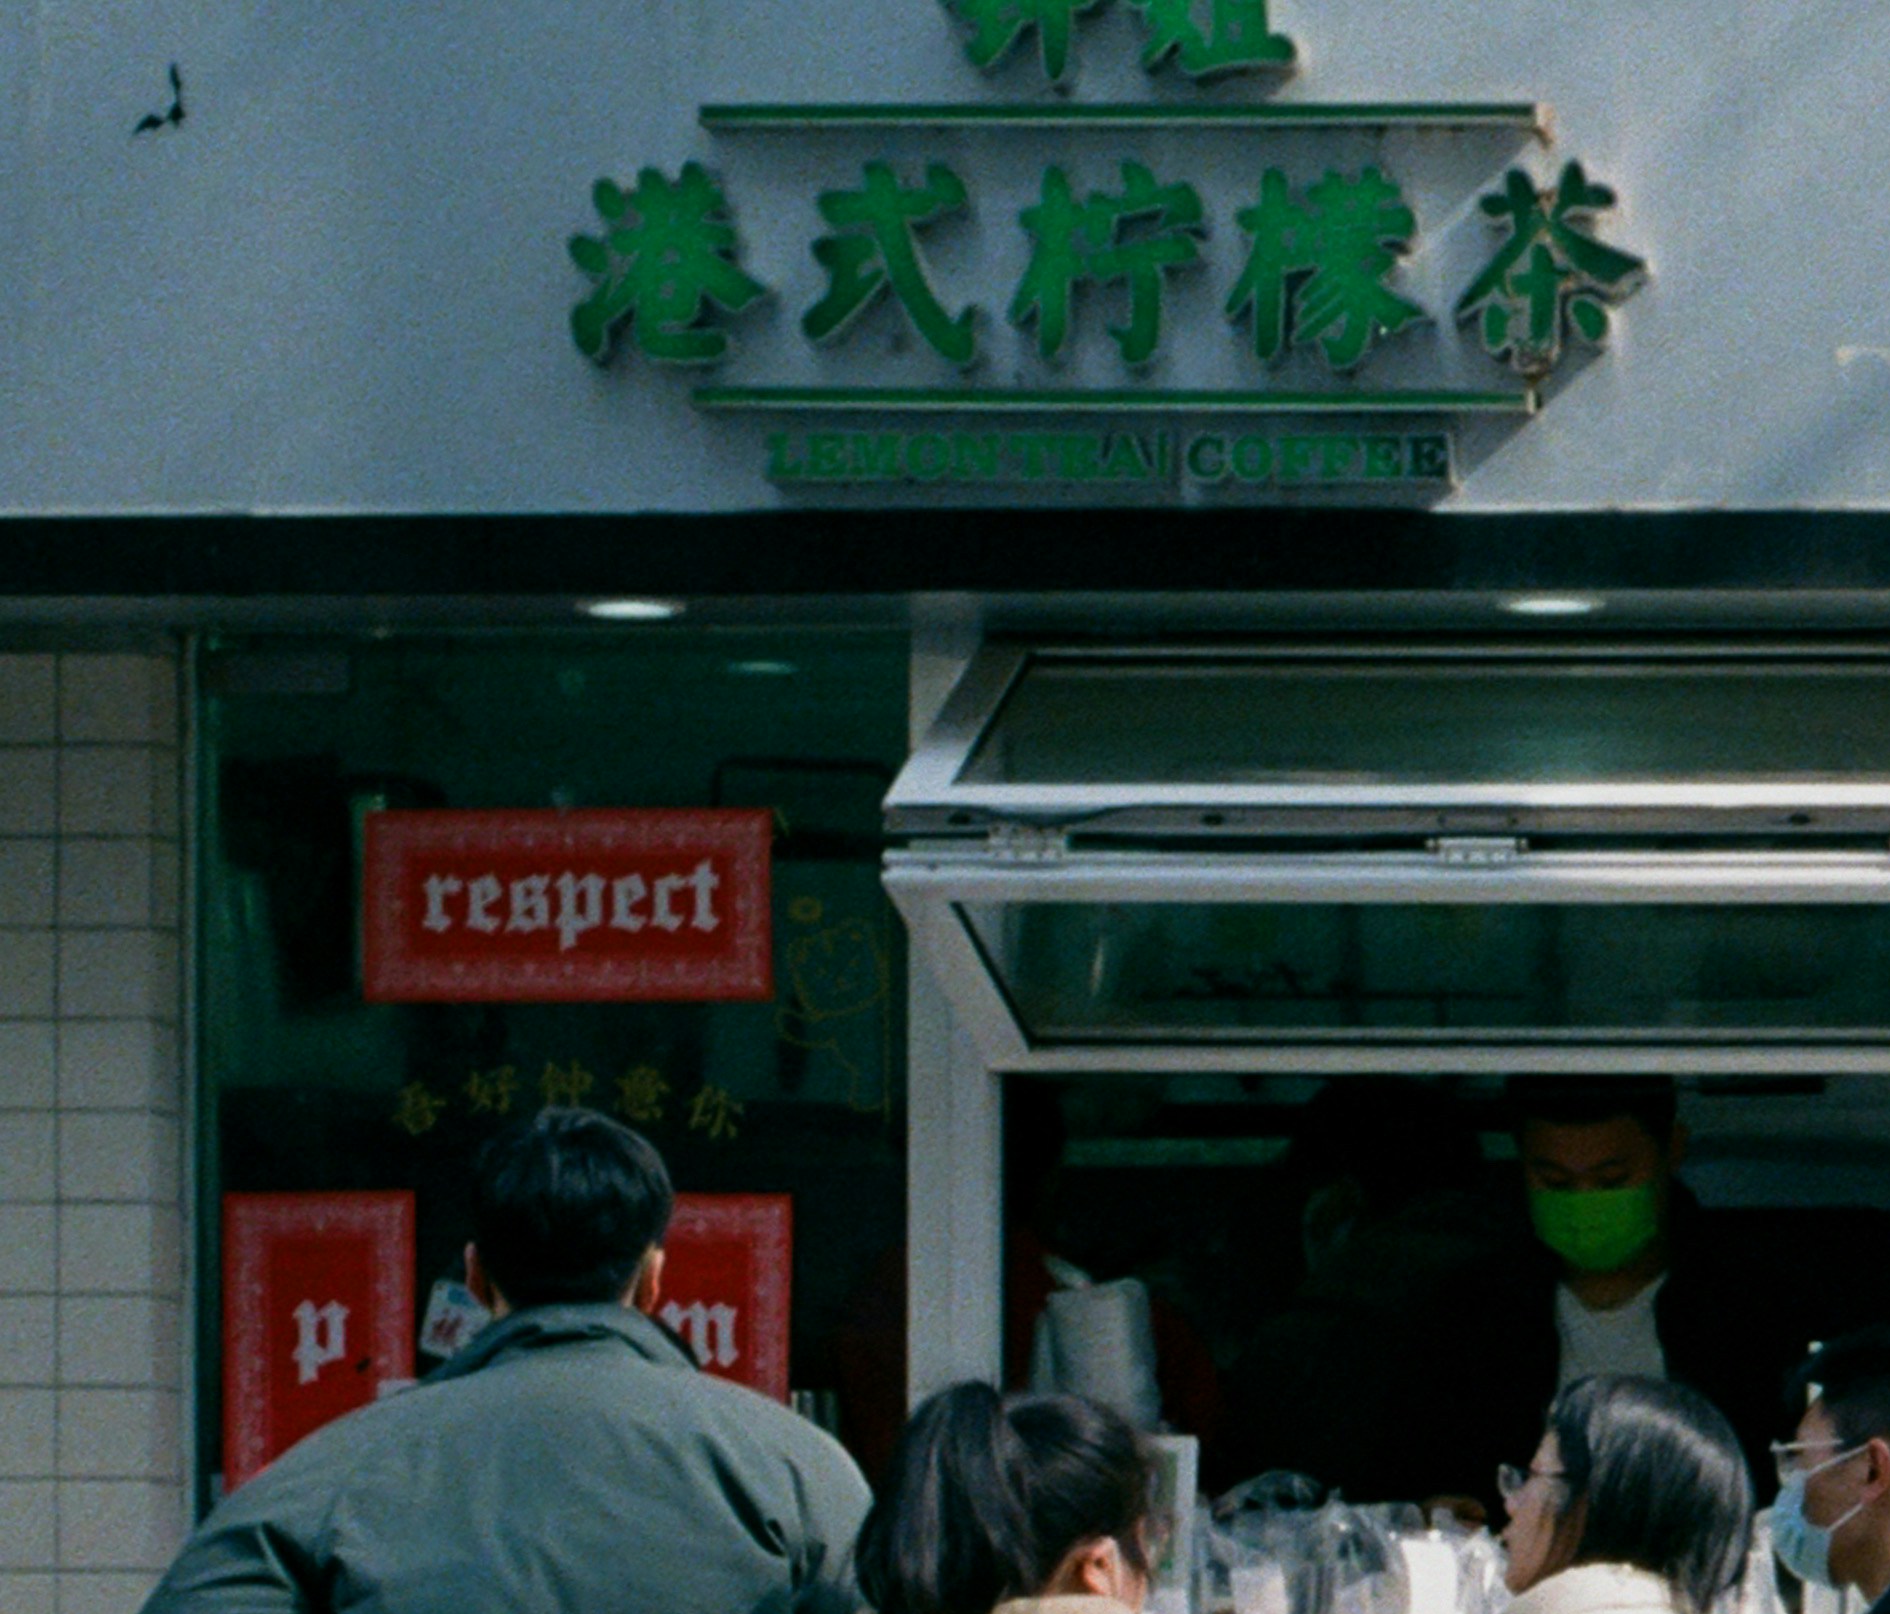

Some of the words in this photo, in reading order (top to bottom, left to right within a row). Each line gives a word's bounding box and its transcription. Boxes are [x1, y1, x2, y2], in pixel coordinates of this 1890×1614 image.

[569, 159, 1650, 373] 港式柠檬茶
[766, 431, 999, 479] LEMON
[1009, 431, 1149, 479] TEA
[1187, 432, 1446, 479] COFFEE
[421, 858, 720, 952] respect
